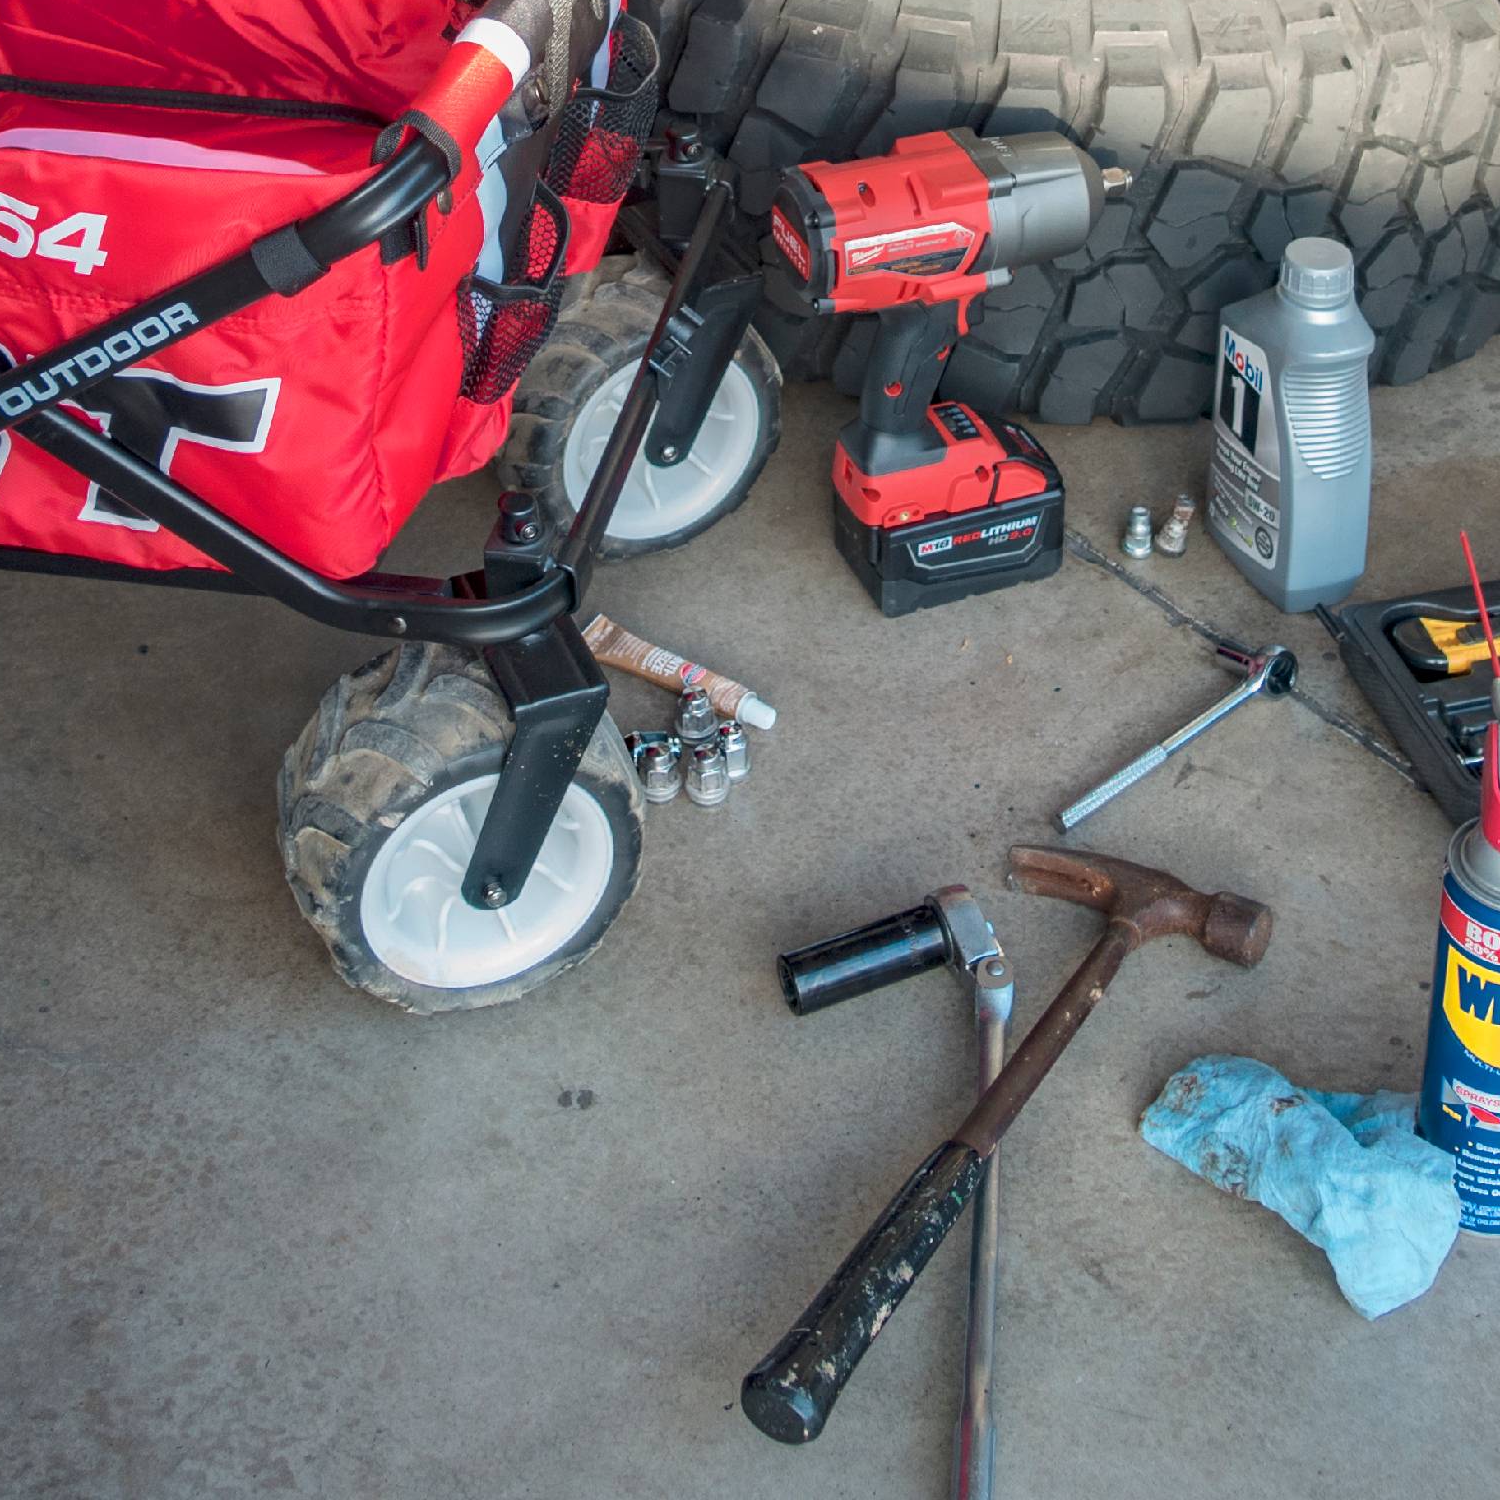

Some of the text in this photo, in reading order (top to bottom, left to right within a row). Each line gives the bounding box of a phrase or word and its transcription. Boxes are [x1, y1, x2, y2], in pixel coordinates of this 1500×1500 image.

[1224, 330, 1263, 392] Mobil
[920, 537, 950, 554] M18
[1464, 938, 1500, 964] 20%
[1455, 1085, 1500, 1107] SPRAYS
